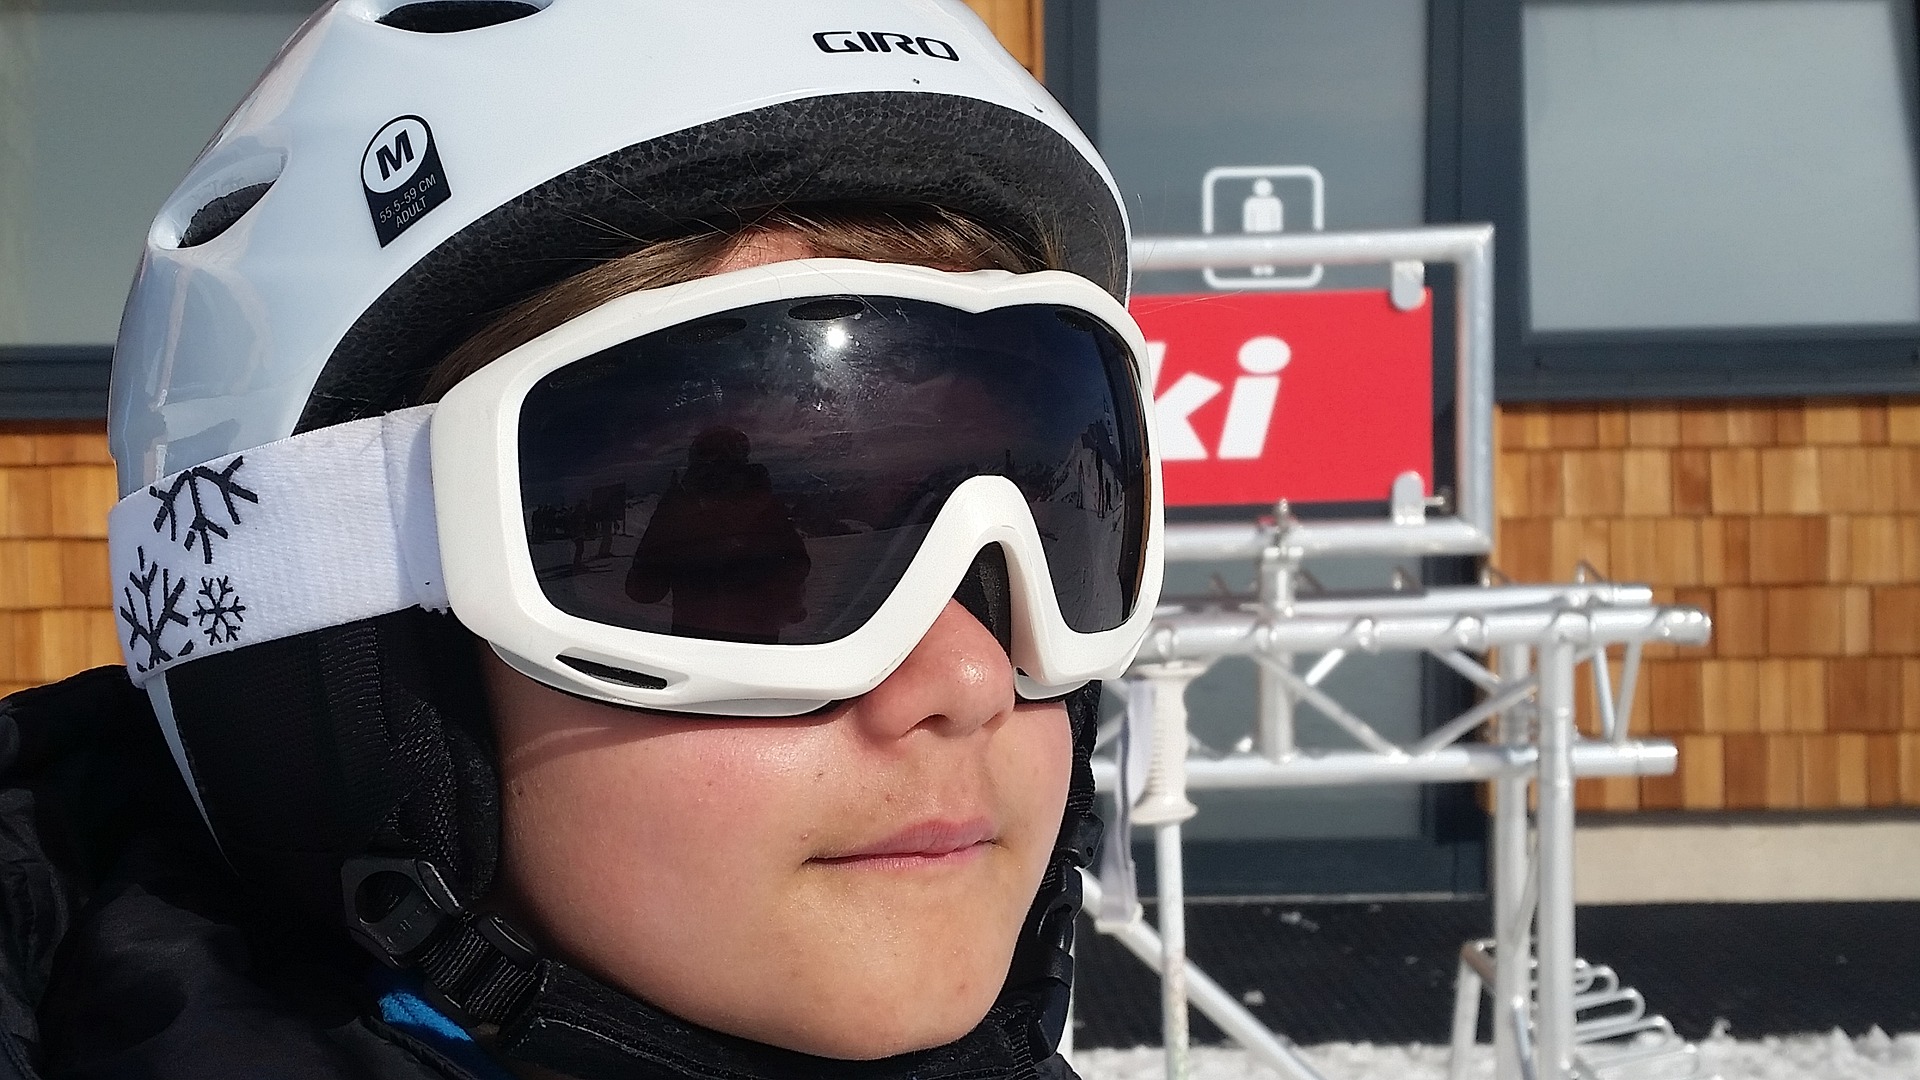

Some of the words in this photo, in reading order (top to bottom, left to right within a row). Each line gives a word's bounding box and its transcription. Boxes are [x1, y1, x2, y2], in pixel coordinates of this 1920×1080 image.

[813, 31, 960, 62] GIRO
[375, 128, 415, 182] M
[379, 187, 417, 223] 55.5-59
[418, 173, 437, 193] CM
[395, 195, 427, 228] ADULT
[1146, 335, 1292, 461] ki
